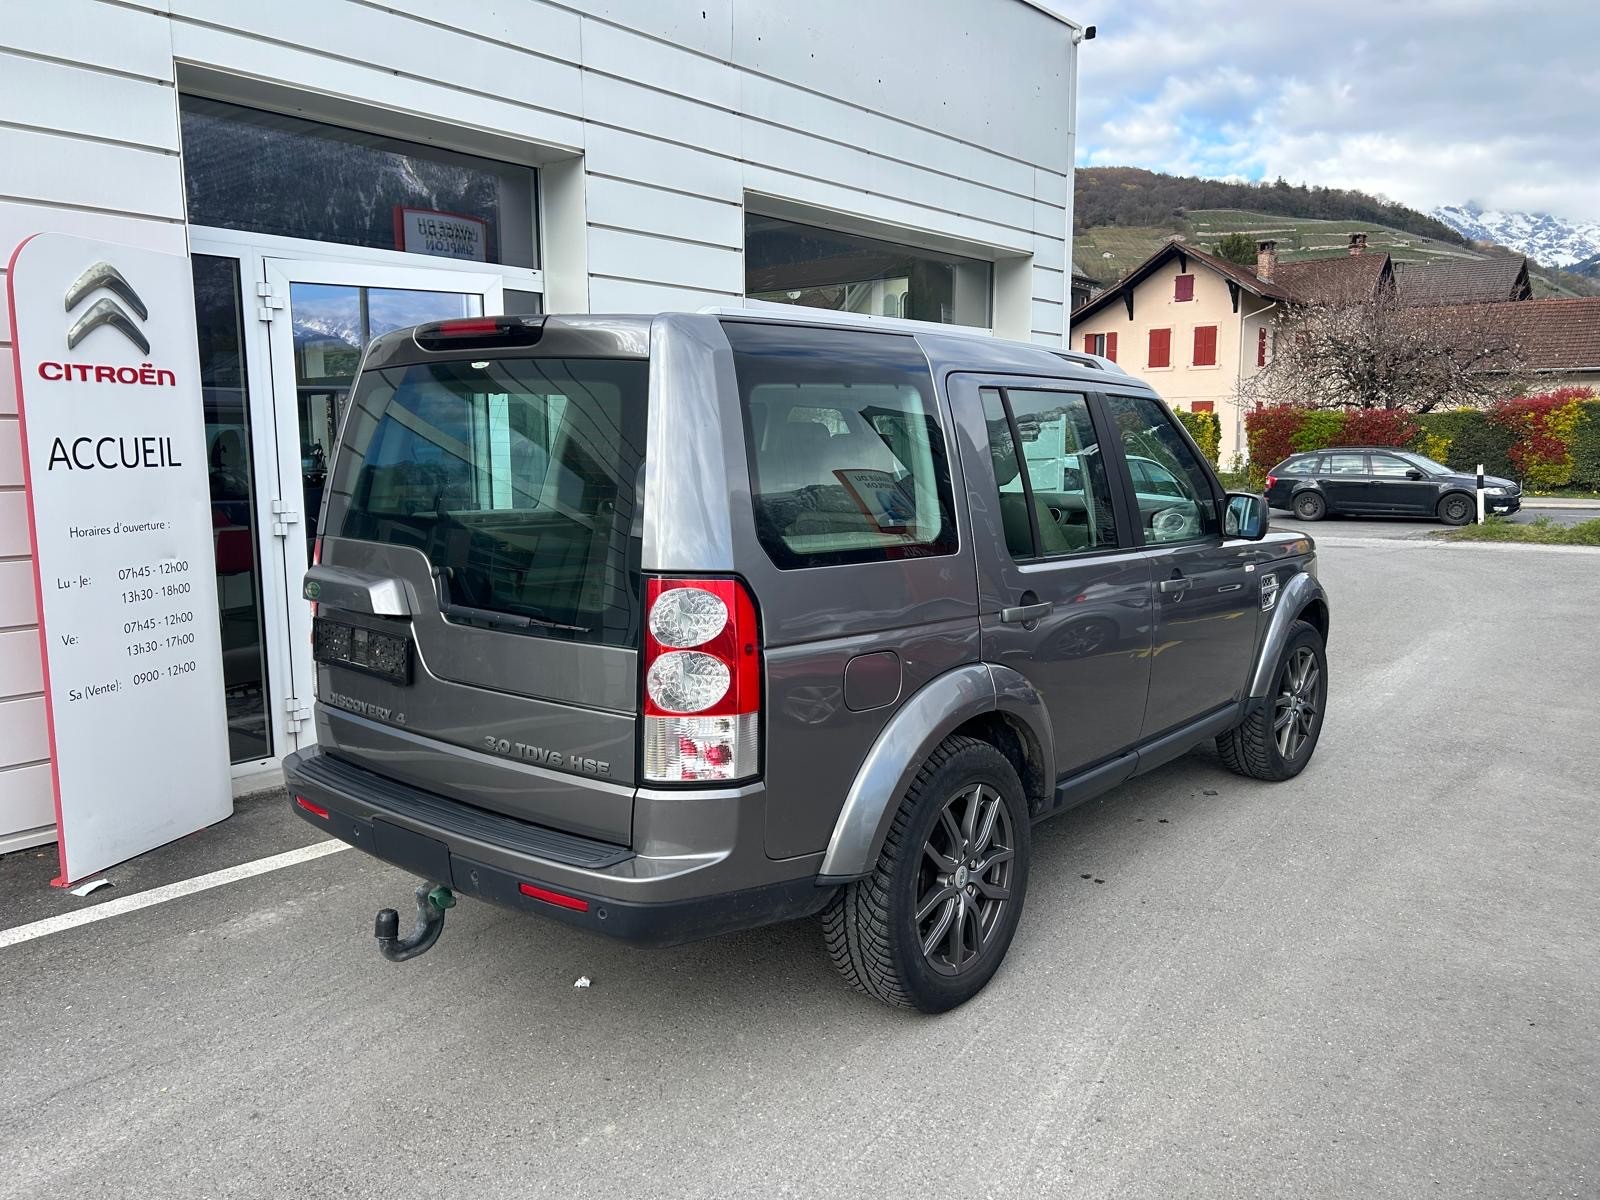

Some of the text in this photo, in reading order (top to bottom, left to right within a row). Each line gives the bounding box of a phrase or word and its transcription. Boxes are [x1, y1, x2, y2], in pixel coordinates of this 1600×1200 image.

[48, 437, 182, 470] ACCUEIL
[69, 525, 111, 538] Horaires
[113, 522, 165, 534] d'ouverture
[57, 578, 71, 589] Lu
[118, 566, 151, 580] 07h45
[159, 561, 189, 574] 12h00
[122, 588, 153, 603] 13h30
[161, 582, 191, 597] 18h00
[61, 635, 79, 646] Ve:
[124, 618, 156, 634] 07h45
[164, 611, 193, 626] 12h00
[127, 640, 158, 656] 13h30
[165, 632, 195, 648] 17h00
[69, 690, 83, 701] Sa
[85, 680, 122, 700] (Vente):
[133, 669, 159, 685] 0900
[167, 661, 196, 677] 12h00
[329, 691, 406, 724] DISCOVERY 4
[484, 735, 612, 777] 3.0 TDV6 HSE
